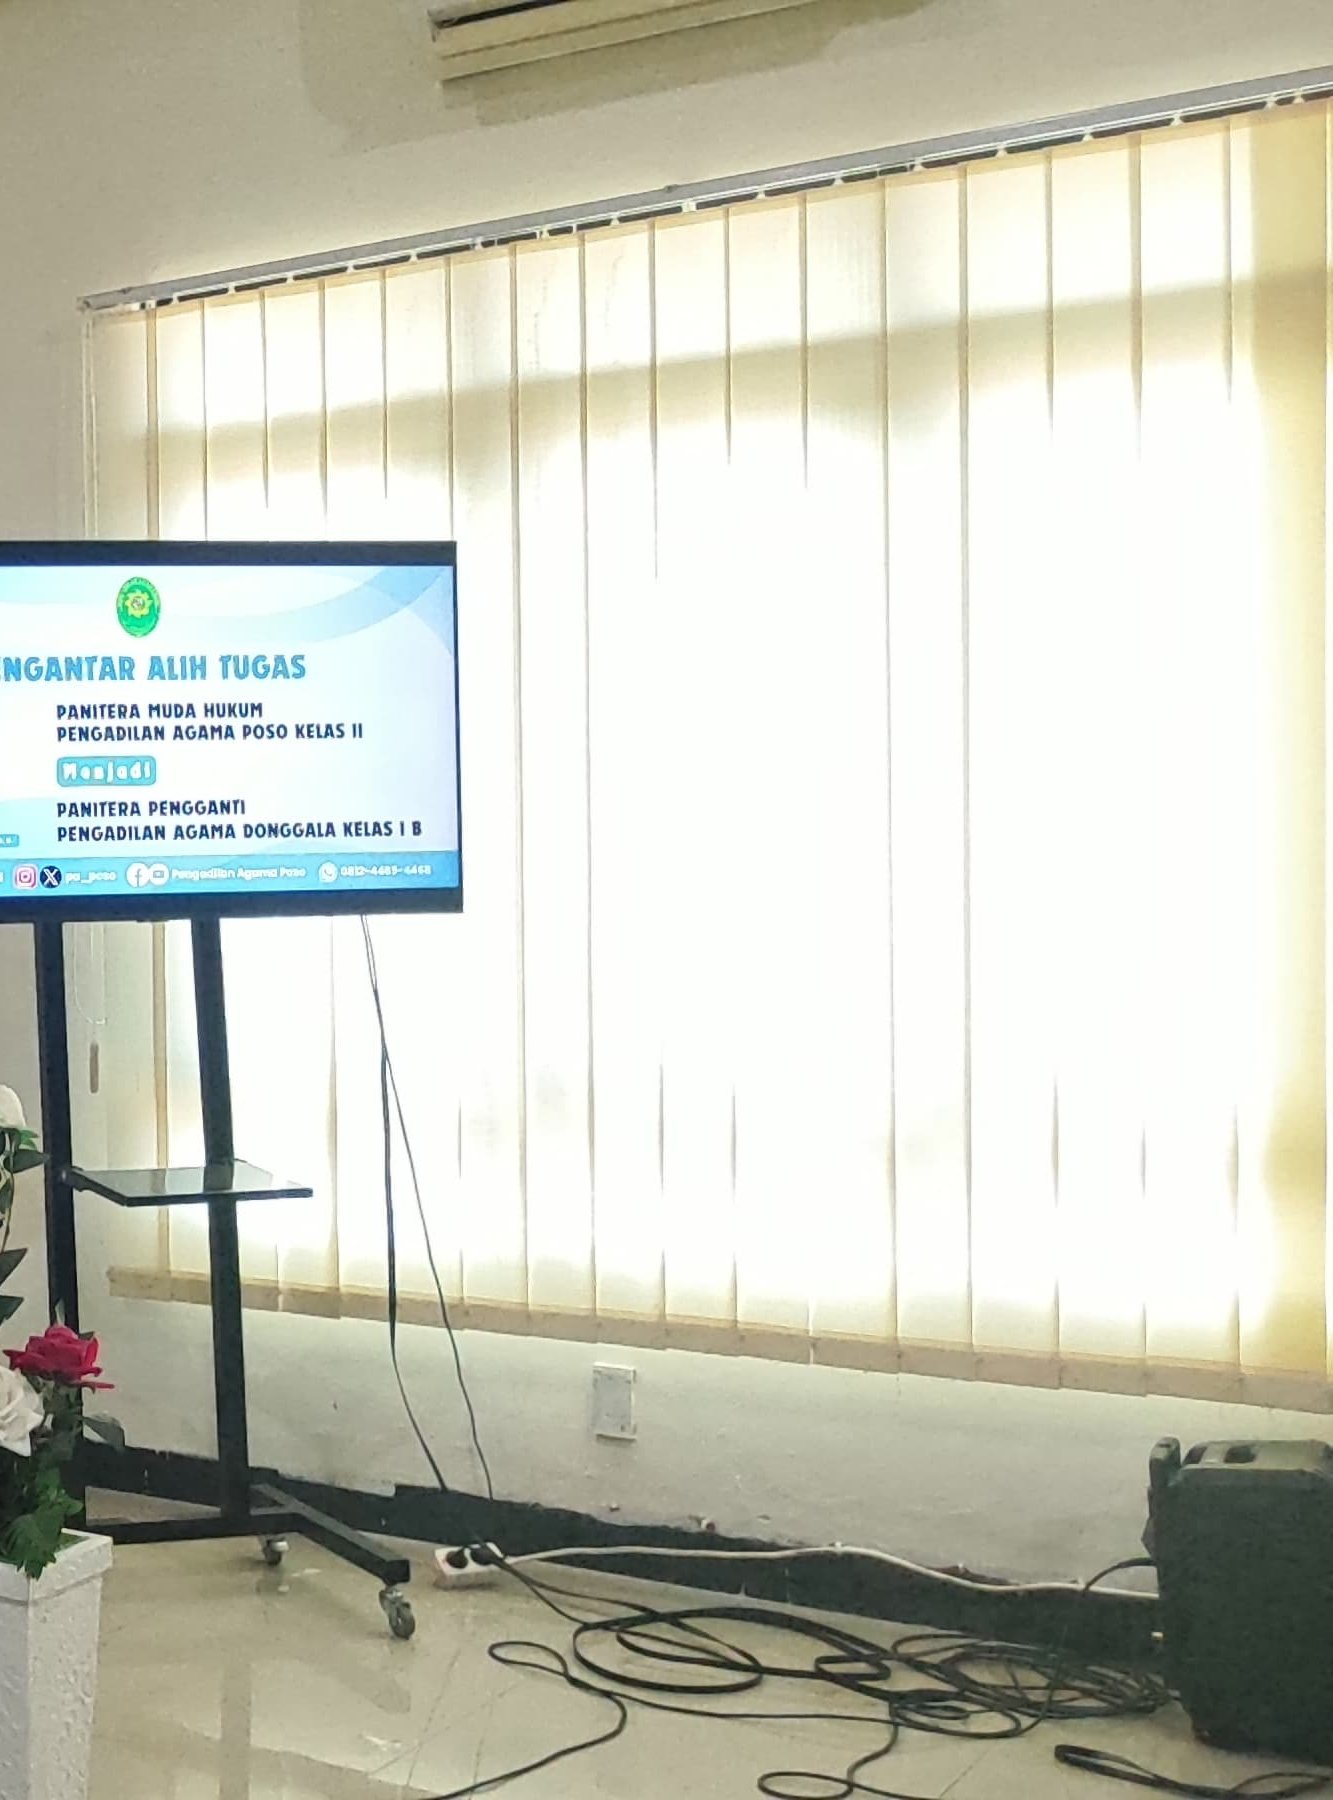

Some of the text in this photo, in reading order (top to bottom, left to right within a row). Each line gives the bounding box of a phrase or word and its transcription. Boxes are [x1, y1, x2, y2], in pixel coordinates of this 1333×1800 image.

[147, 655, 207, 680] ALIH
[219, 654, 306, 680] TUGAS
[56, 702, 263, 720] PANITERA MUDA HUKUM
[57, 723, 363, 742] PENGADILAN AGAMA POSO KELAS II
[62, 760, 152, 784] Menjadi
[56, 799, 246, 818] PANITERA PENGGANTI
[57, 820, 422, 842] PENGADILAN AGAMA DONGGALA KELAS I B
